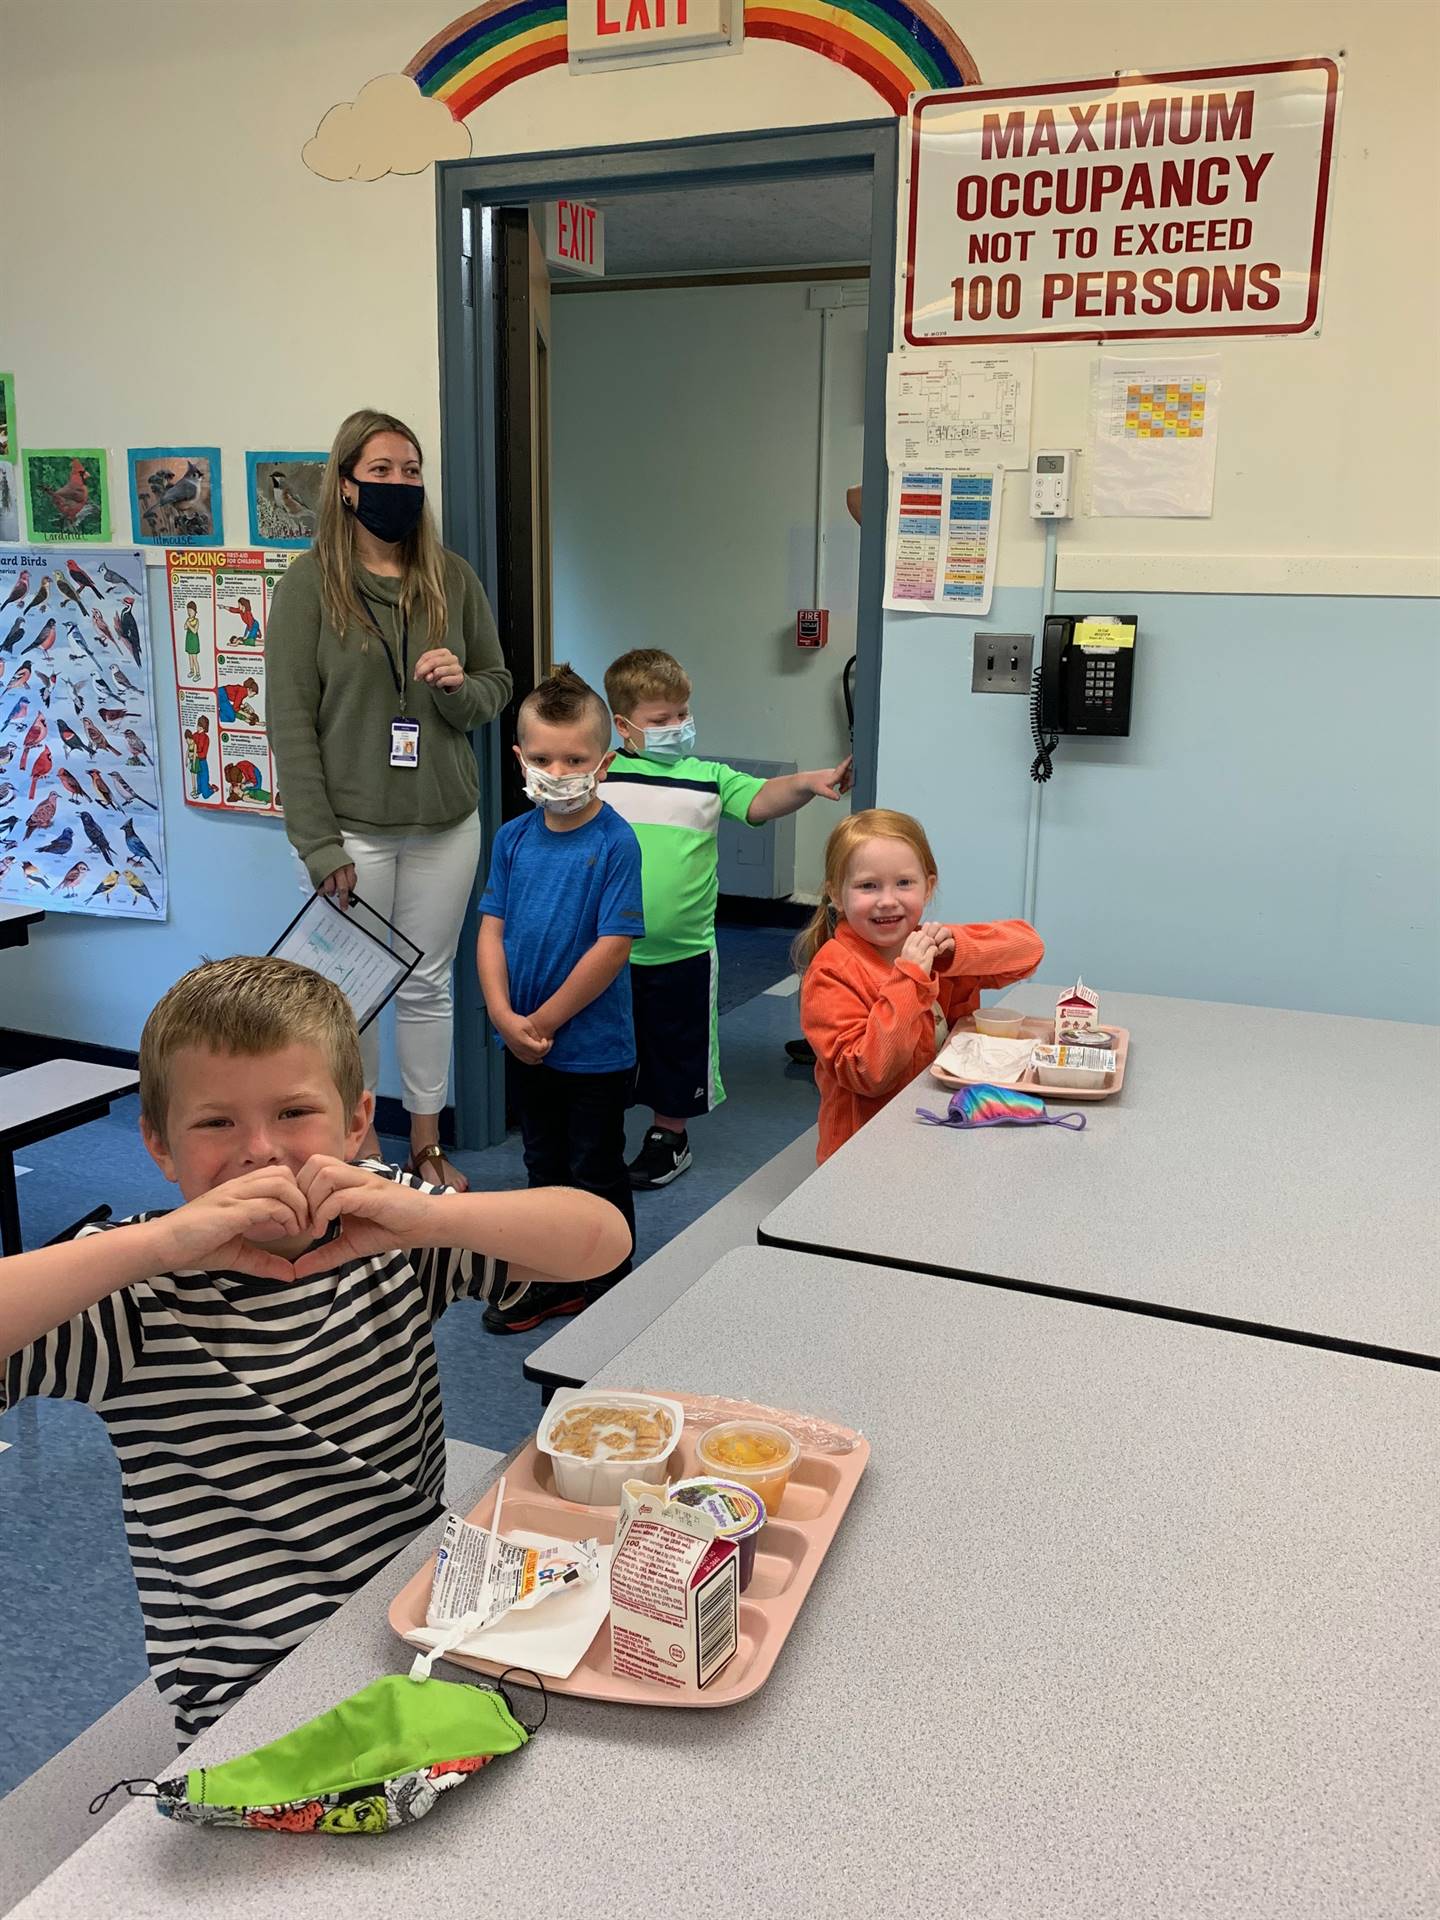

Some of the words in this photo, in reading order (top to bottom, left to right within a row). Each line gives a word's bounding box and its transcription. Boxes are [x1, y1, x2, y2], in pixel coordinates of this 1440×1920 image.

[980, 90, 1256, 161] MAXIMUM
[956, 152, 1275, 221] OCCUPANCY
[558, 200, 596, 265] EXIT
[968, 230, 1036, 264] NOT
[1053, 226, 1098, 259] TO
[1113, 217, 1253, 257] EXCEED
[950, 272, 1022, 321] 100
[1041, 262, 1282, 319] PERSONS
[20, 555, 48, 567] Birds
[169, 551, 227, 567] CHOKING
[800, 611, 820, 620] FIRE
[633, 1522, 658, 1531] Nutrition
[659, 1527, 676, 1537] Facts
[664, 1544, 685, 1554] Calories
